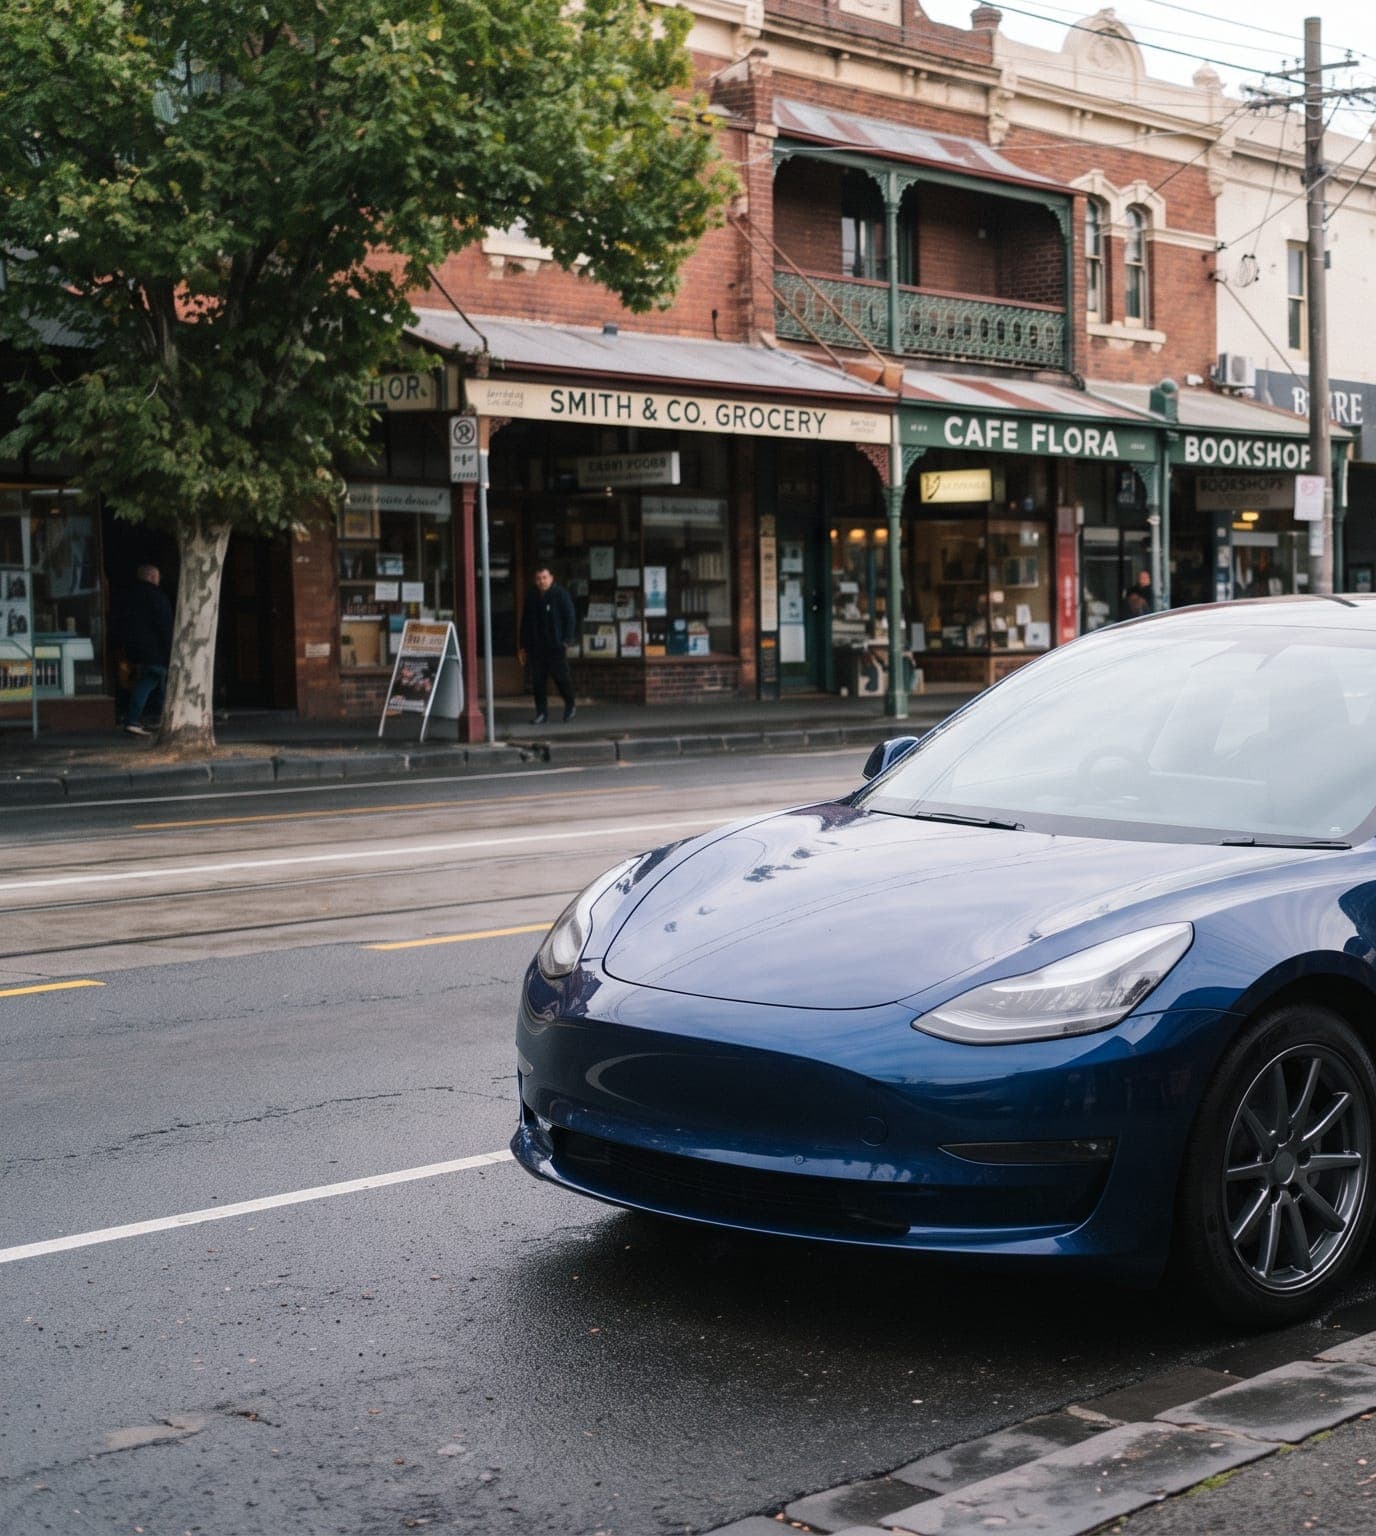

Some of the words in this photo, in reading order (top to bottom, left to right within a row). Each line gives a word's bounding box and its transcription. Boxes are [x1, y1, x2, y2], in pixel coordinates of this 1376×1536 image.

[550, 389, 632, 419] SMITH
[641, 397, 658, 422] &
[666, 400, 707, 426] CO.
[715, 404, 827, 434] GROCERY
[1292, 387, 1364, 425] BRE
[943, 416, 1019, 450] CAFE
[1031, 424, 1120, 458] FLORA
